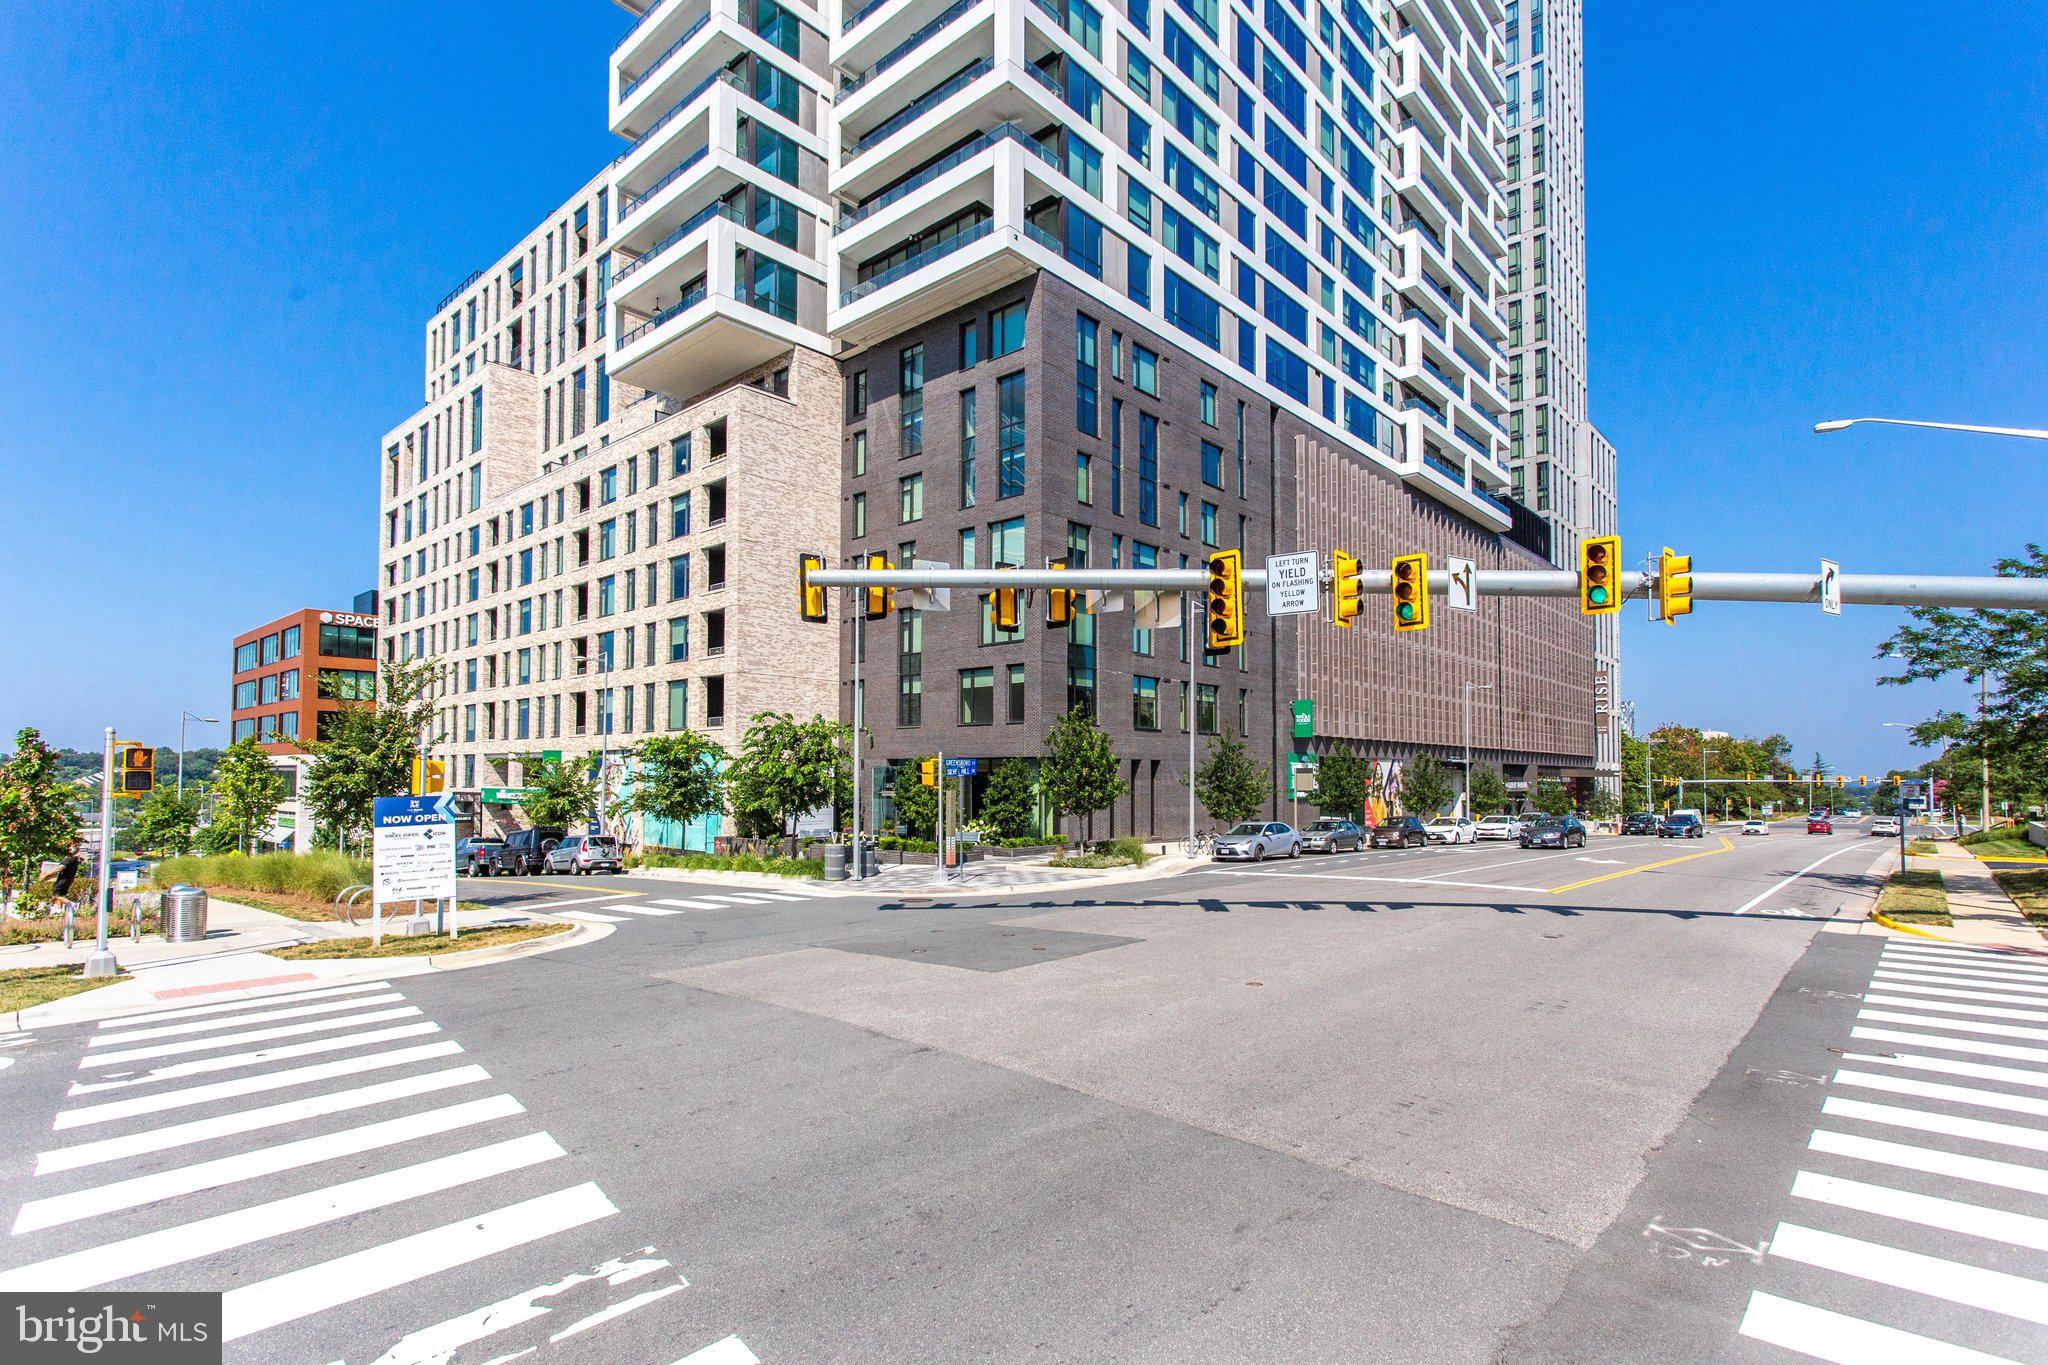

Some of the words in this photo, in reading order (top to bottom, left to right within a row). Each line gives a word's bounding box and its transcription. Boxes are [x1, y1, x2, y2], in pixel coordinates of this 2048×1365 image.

[1275, 559, 1290, 567] LEFT
[1292, 557, 1309, 565] TURN
[1279, 567, 1306, 579] YIELD
[1282, 578, 1314, 587] FLASHING
[1280, 589, 1305, 597] YELLOW
[1825, 598, 1838, 609] ONLY
[1595, 676, 1608, 713] RISE
[382, 815, 412, 824] NOW
[414, 813, 446, 822] OPEN
